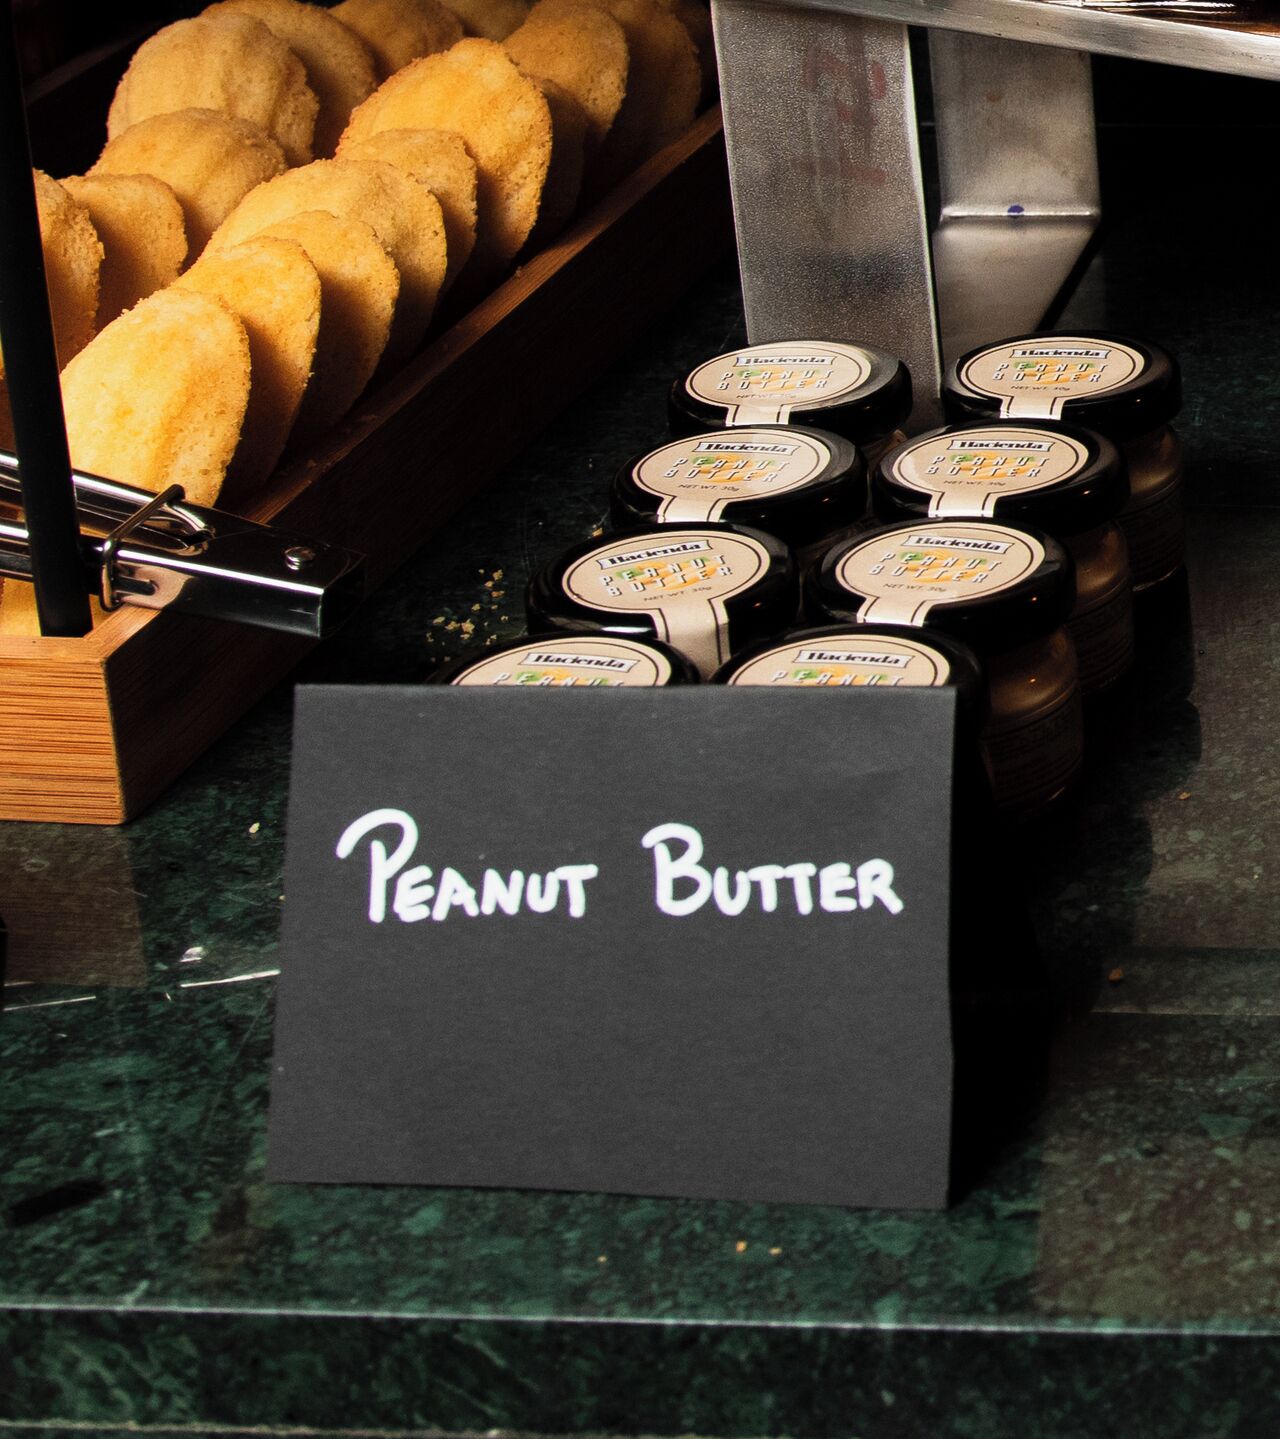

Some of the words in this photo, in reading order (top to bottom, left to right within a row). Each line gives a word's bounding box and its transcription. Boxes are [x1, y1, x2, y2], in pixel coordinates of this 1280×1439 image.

[997, 364, 1108, 372] PEANUT
[721, 370, 835, 380] PEANUT
[992, 373, 1101, 382] BUTTER
[717, 380, 827, 390] BUTTER
[704, 443, 788, 452] Hacienda
[673, 458, 790, 471] PEANUT
[932, 456, 1050, 466] PEANUT
[664, 470, 778, 482] BUTTER
[926, 467, 1041, 477] BUTTER
[915, 538, 1001, 550] Hacienda
[608, 543, 701, 565] Hacienda
[880, 552, 1001, 571] PEANUT
[600, 555, 726, 586] PEANUT
[869, 565, 988, 583] BUTTER
[608, 567, 732, 597] BUTTER
[534, 655, 624, 668] Hacienda
[807, 653, 900, 664] Hacienda
[772, 670, 903, 686] PEANUT
[336, 808, 599, 923] PEANUT
[641, 822, 904, 916] BUTTER
